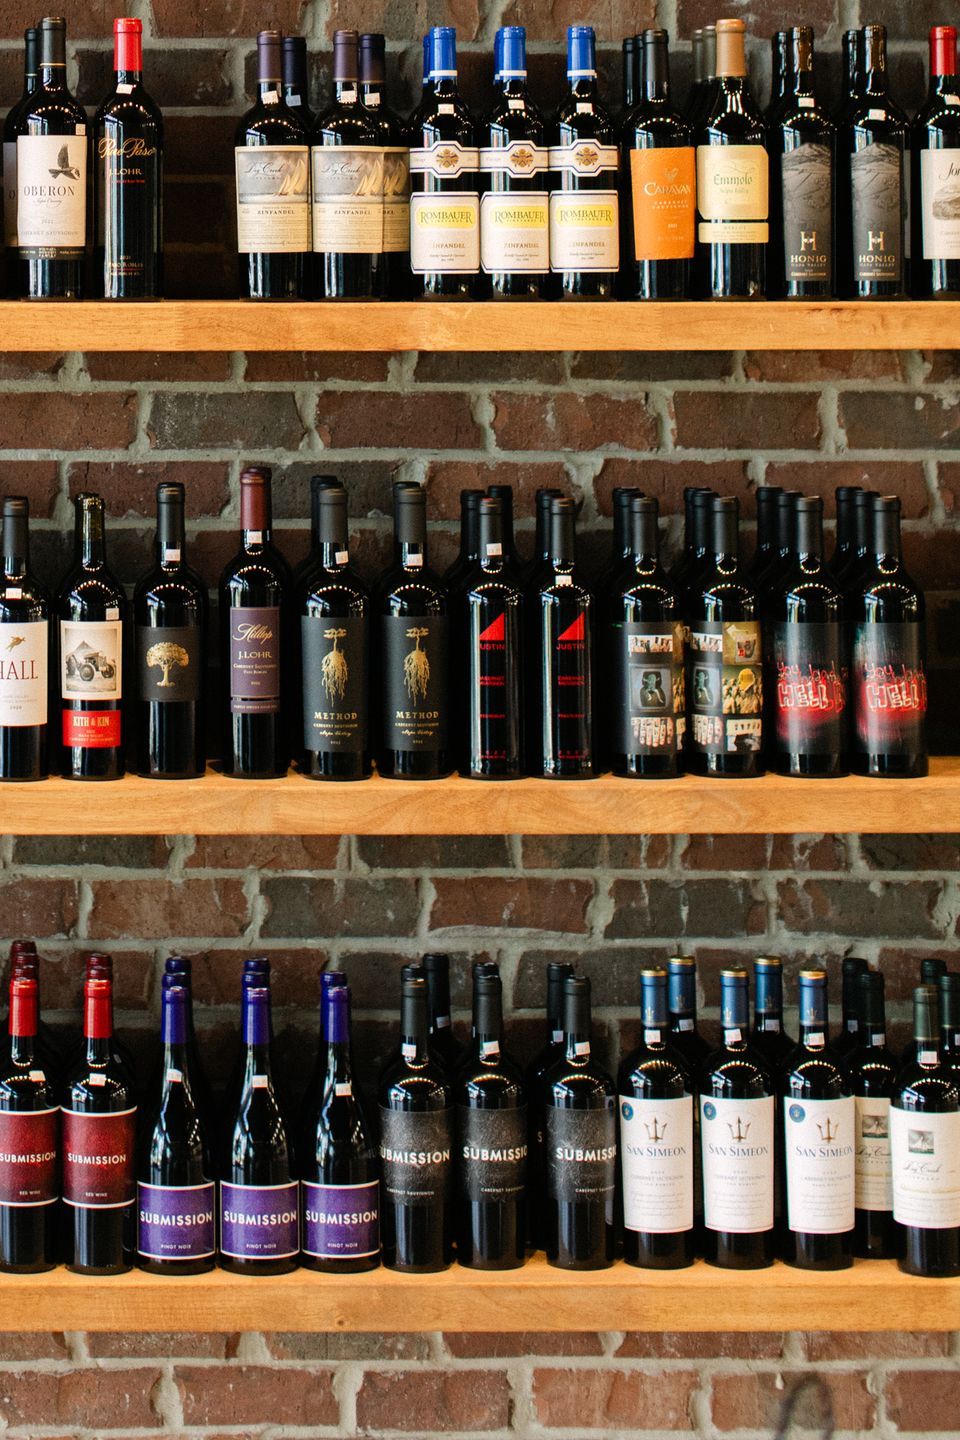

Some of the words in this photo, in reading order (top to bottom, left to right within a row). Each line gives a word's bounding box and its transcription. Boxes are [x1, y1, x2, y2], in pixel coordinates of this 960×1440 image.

[713, 173, 753, 187] Emmolo
[23, 184, 76, 197] OBERON
[419, 210, 473, 225] ROMBAUER
[494, 210, 546, 225] ROMBAUER
[559, 209, 613, 223] ROMBAUER
[791, 255, 827, 263] HONIG
[858, 255, 896, 263] HONIG
[556, 643, 586, 651] JUSTIN
[313, 711, 358, 720] METHOD
[395, 710, 439, 720] METHOD
[0, 1151, 57, 1163] SUBMISSION
[626, 1143, 645, 1156] SAN
[646, 1144, 687, 1157] SIMEON
[708, 1143, 727, 1156] SAN
[729, 1144, 769, 1157] SIMEON
[795, 1143, 816, 1157] SAN
[818, 1144, 854, 1157] SIMEON
[67, 1152, 127, 1165] SUBMISSION
[140, 1210, 214, 1226] SUBMISSION
[224, 1210, 297, 1226] SUBMISSION
[305, 1209, 379, 1225] SUBMISSION
